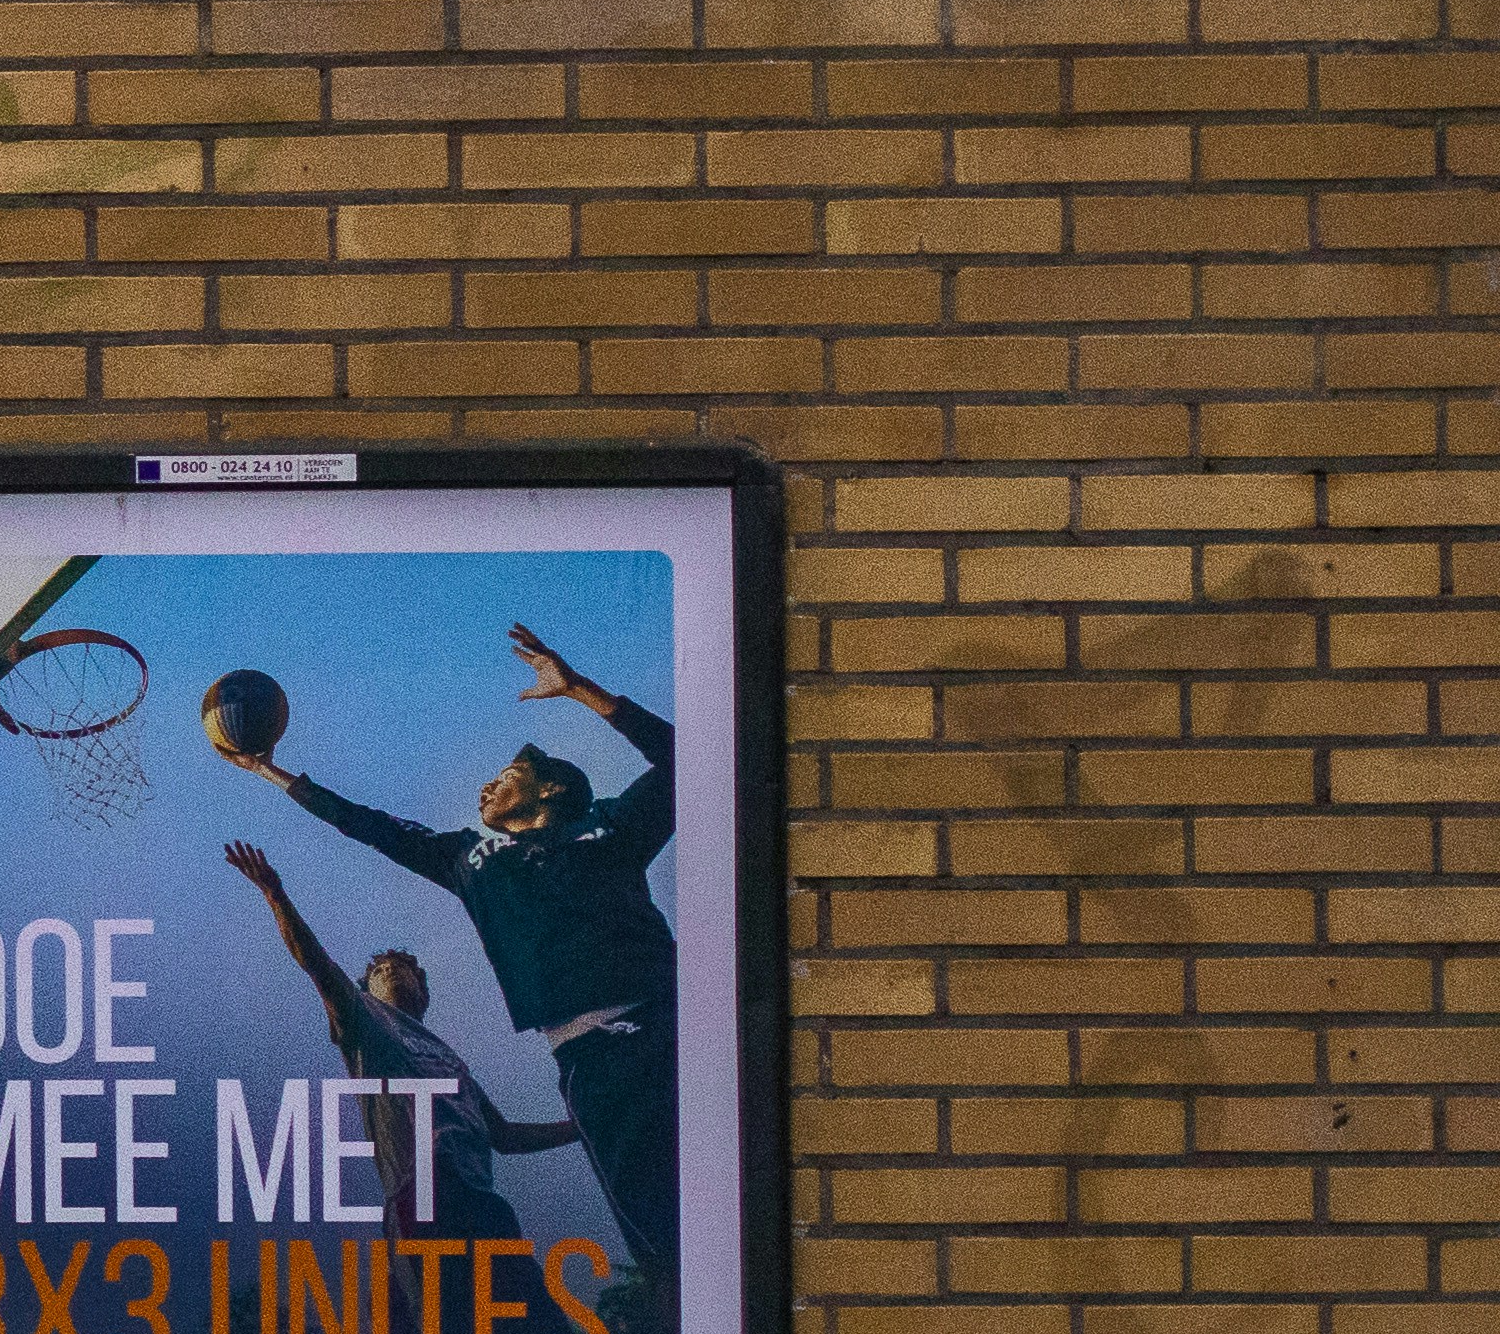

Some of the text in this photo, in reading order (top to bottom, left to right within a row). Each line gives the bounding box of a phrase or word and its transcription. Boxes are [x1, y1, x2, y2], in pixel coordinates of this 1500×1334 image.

[171, 461, 208, 474] 0800
[220, 460, 247, 473] 024
[253, 460, 271, 473] 24
[274, 460, 293, 473] 10
[216, 1078, 459, 1223] MET
